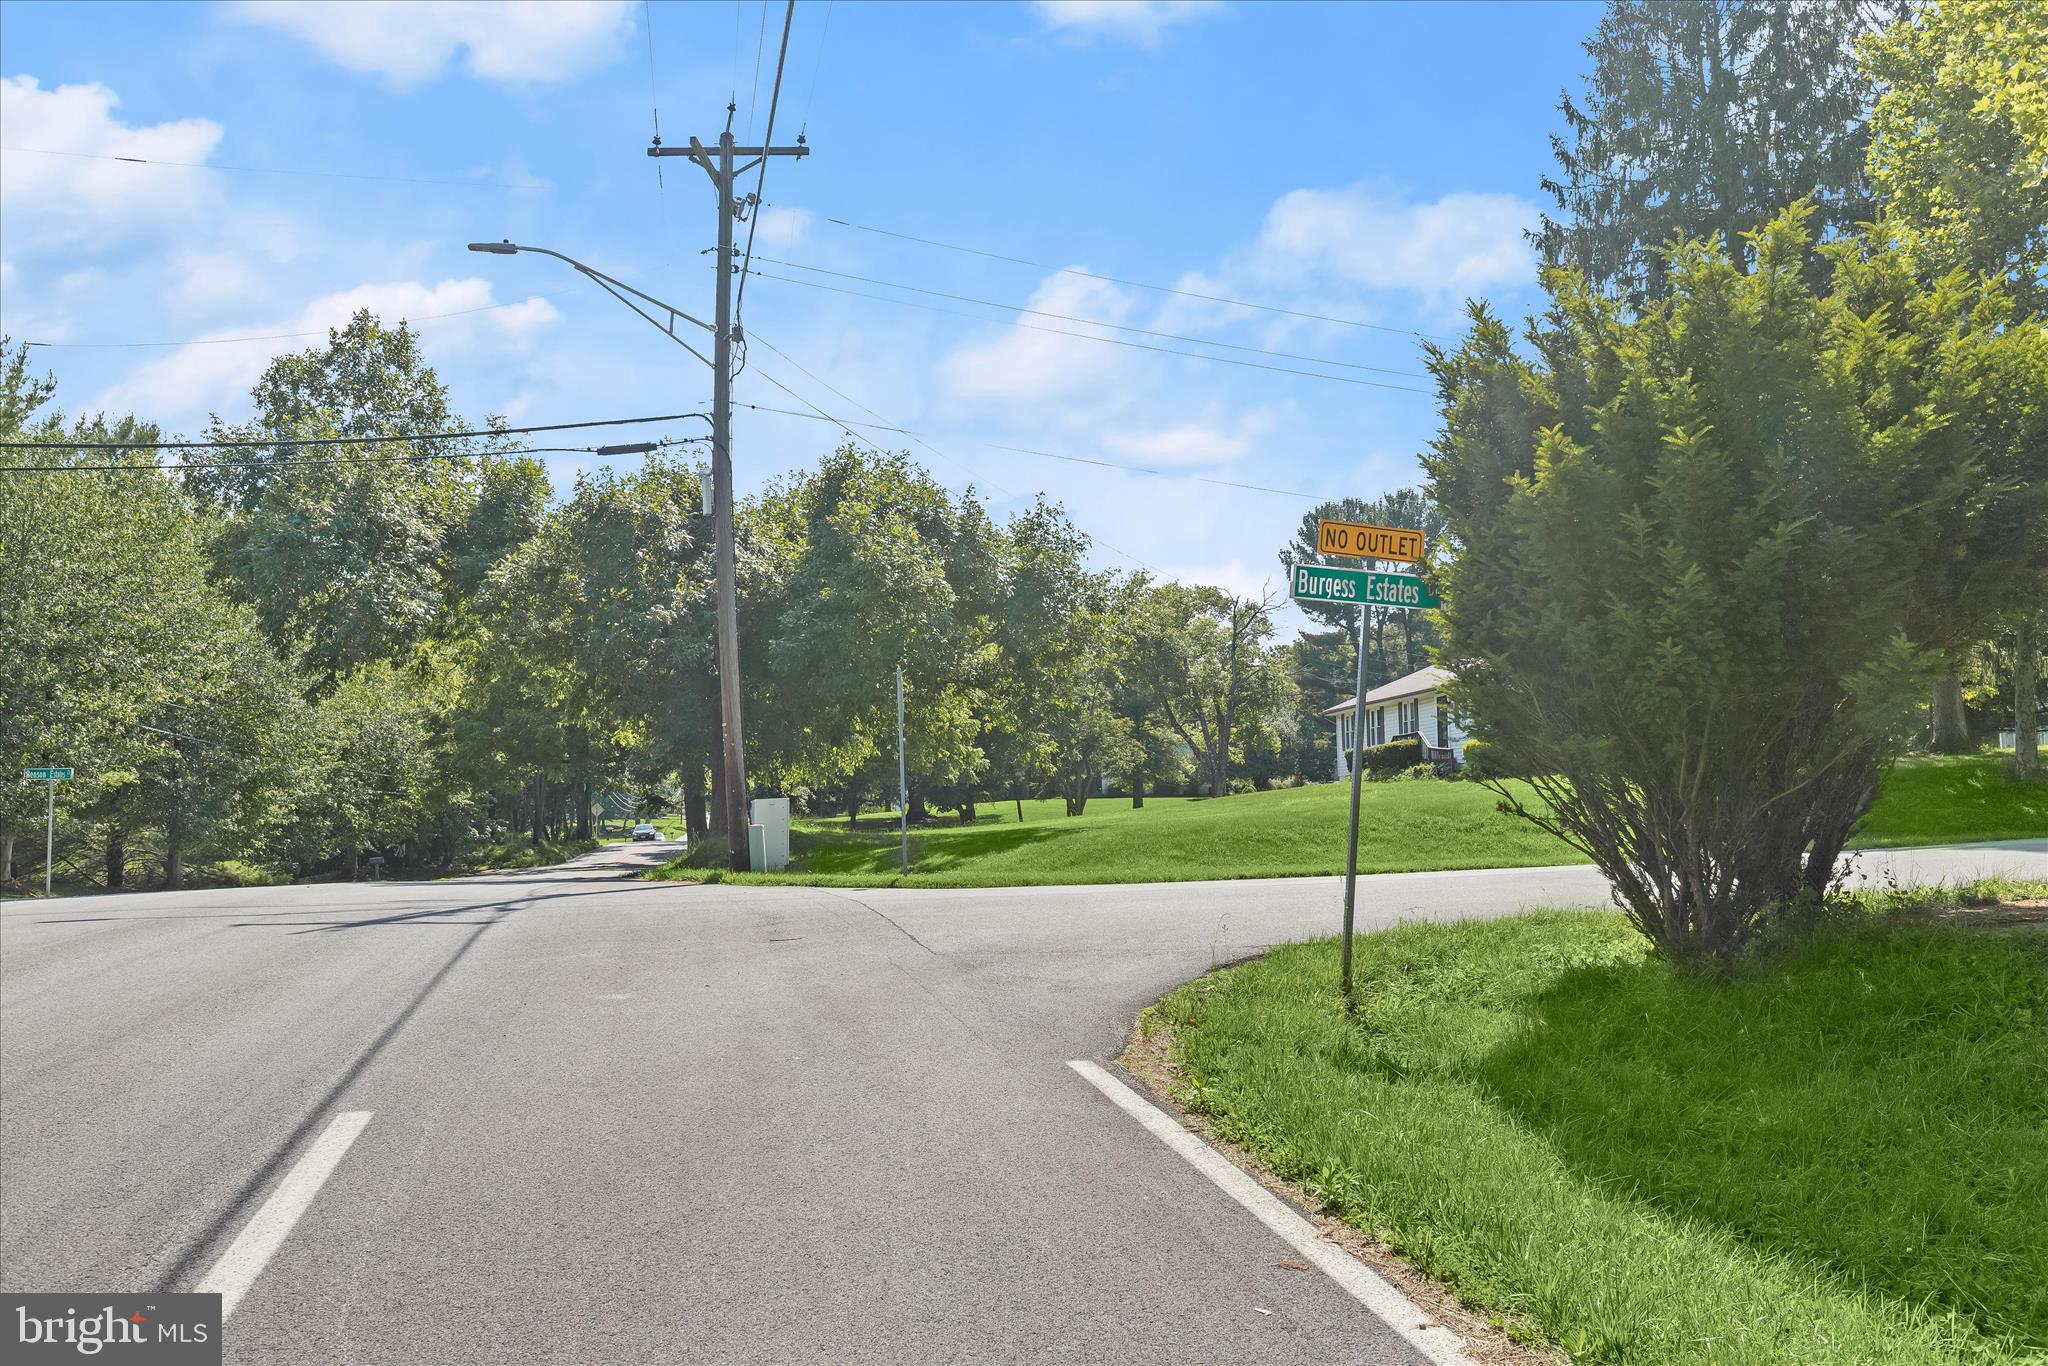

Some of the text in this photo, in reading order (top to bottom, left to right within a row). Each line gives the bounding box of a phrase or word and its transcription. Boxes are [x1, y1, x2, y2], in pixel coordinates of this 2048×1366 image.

[1325, 527, 1418, 557] NO OUTLET
[1298, 569, 1356, 599] Burgess
[1366, 575, 1419, 604] Estates
